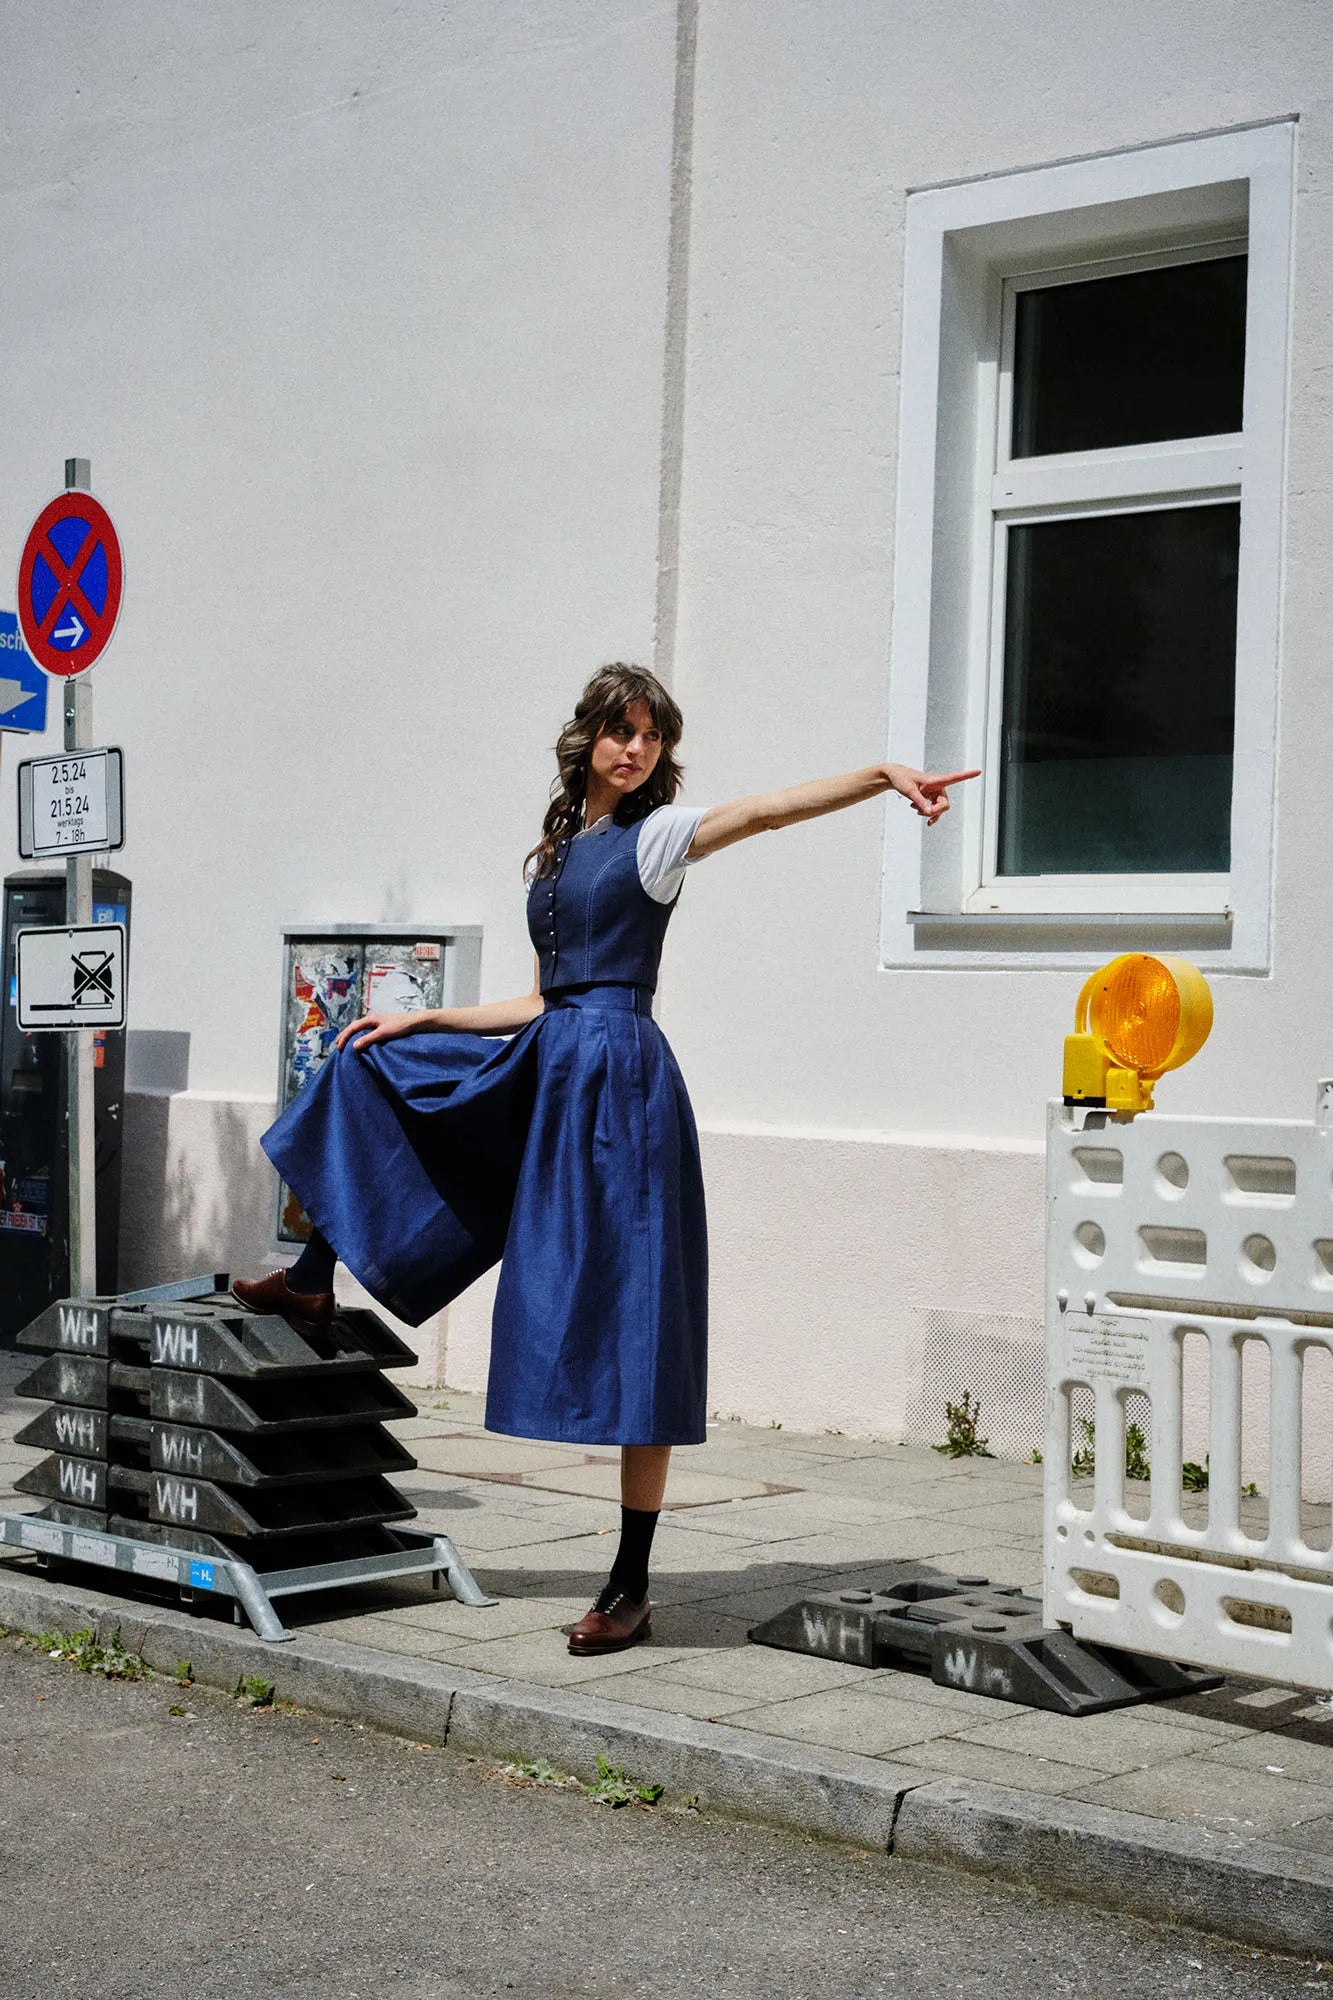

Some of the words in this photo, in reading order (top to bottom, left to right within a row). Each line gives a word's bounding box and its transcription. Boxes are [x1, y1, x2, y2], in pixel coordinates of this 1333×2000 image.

[51, 761, 86, 784] 2.5.24
[65, 785, 74, 794] bis
[51, 795, 89, 818] 21.5.24
[57, 817, 84, 828] werktags
[56, 831, 61, 844] 7
[72, 828, 85, 842] 18h
[59, 1307, 98, 1346] WH
[152, 1323, 198, 1363] WH
[56, 1412, 95, 1450] WH
[161, 1431, 203, 1470] WH
[60, 1459, 97, 1502] WH
[156, 1479, 198, 1521] WH
[802, 1607, 866, 1656] WH
